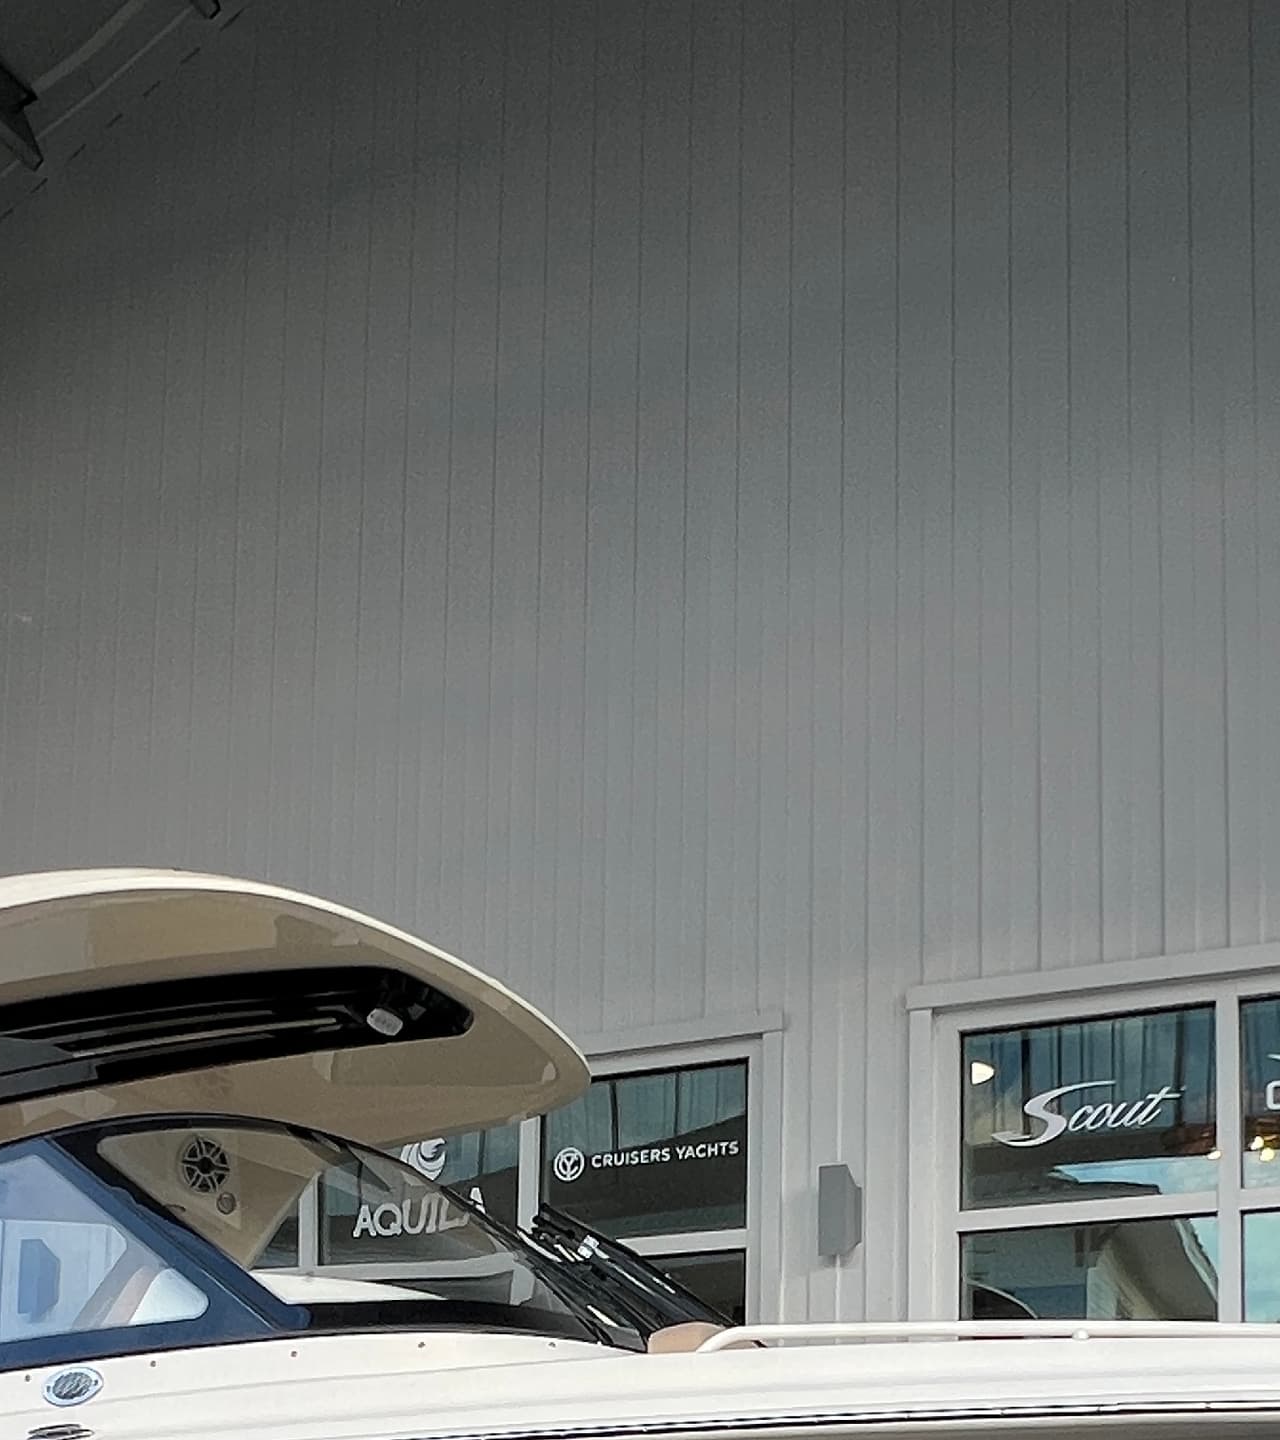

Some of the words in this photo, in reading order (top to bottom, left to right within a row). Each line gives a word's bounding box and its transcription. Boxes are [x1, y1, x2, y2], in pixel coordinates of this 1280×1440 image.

[992, 1080, 1183, 1147] Scout
[591, 1148, 671, 1169] CRUISERS
[675, 1140, 740, 1160] YACHTS
